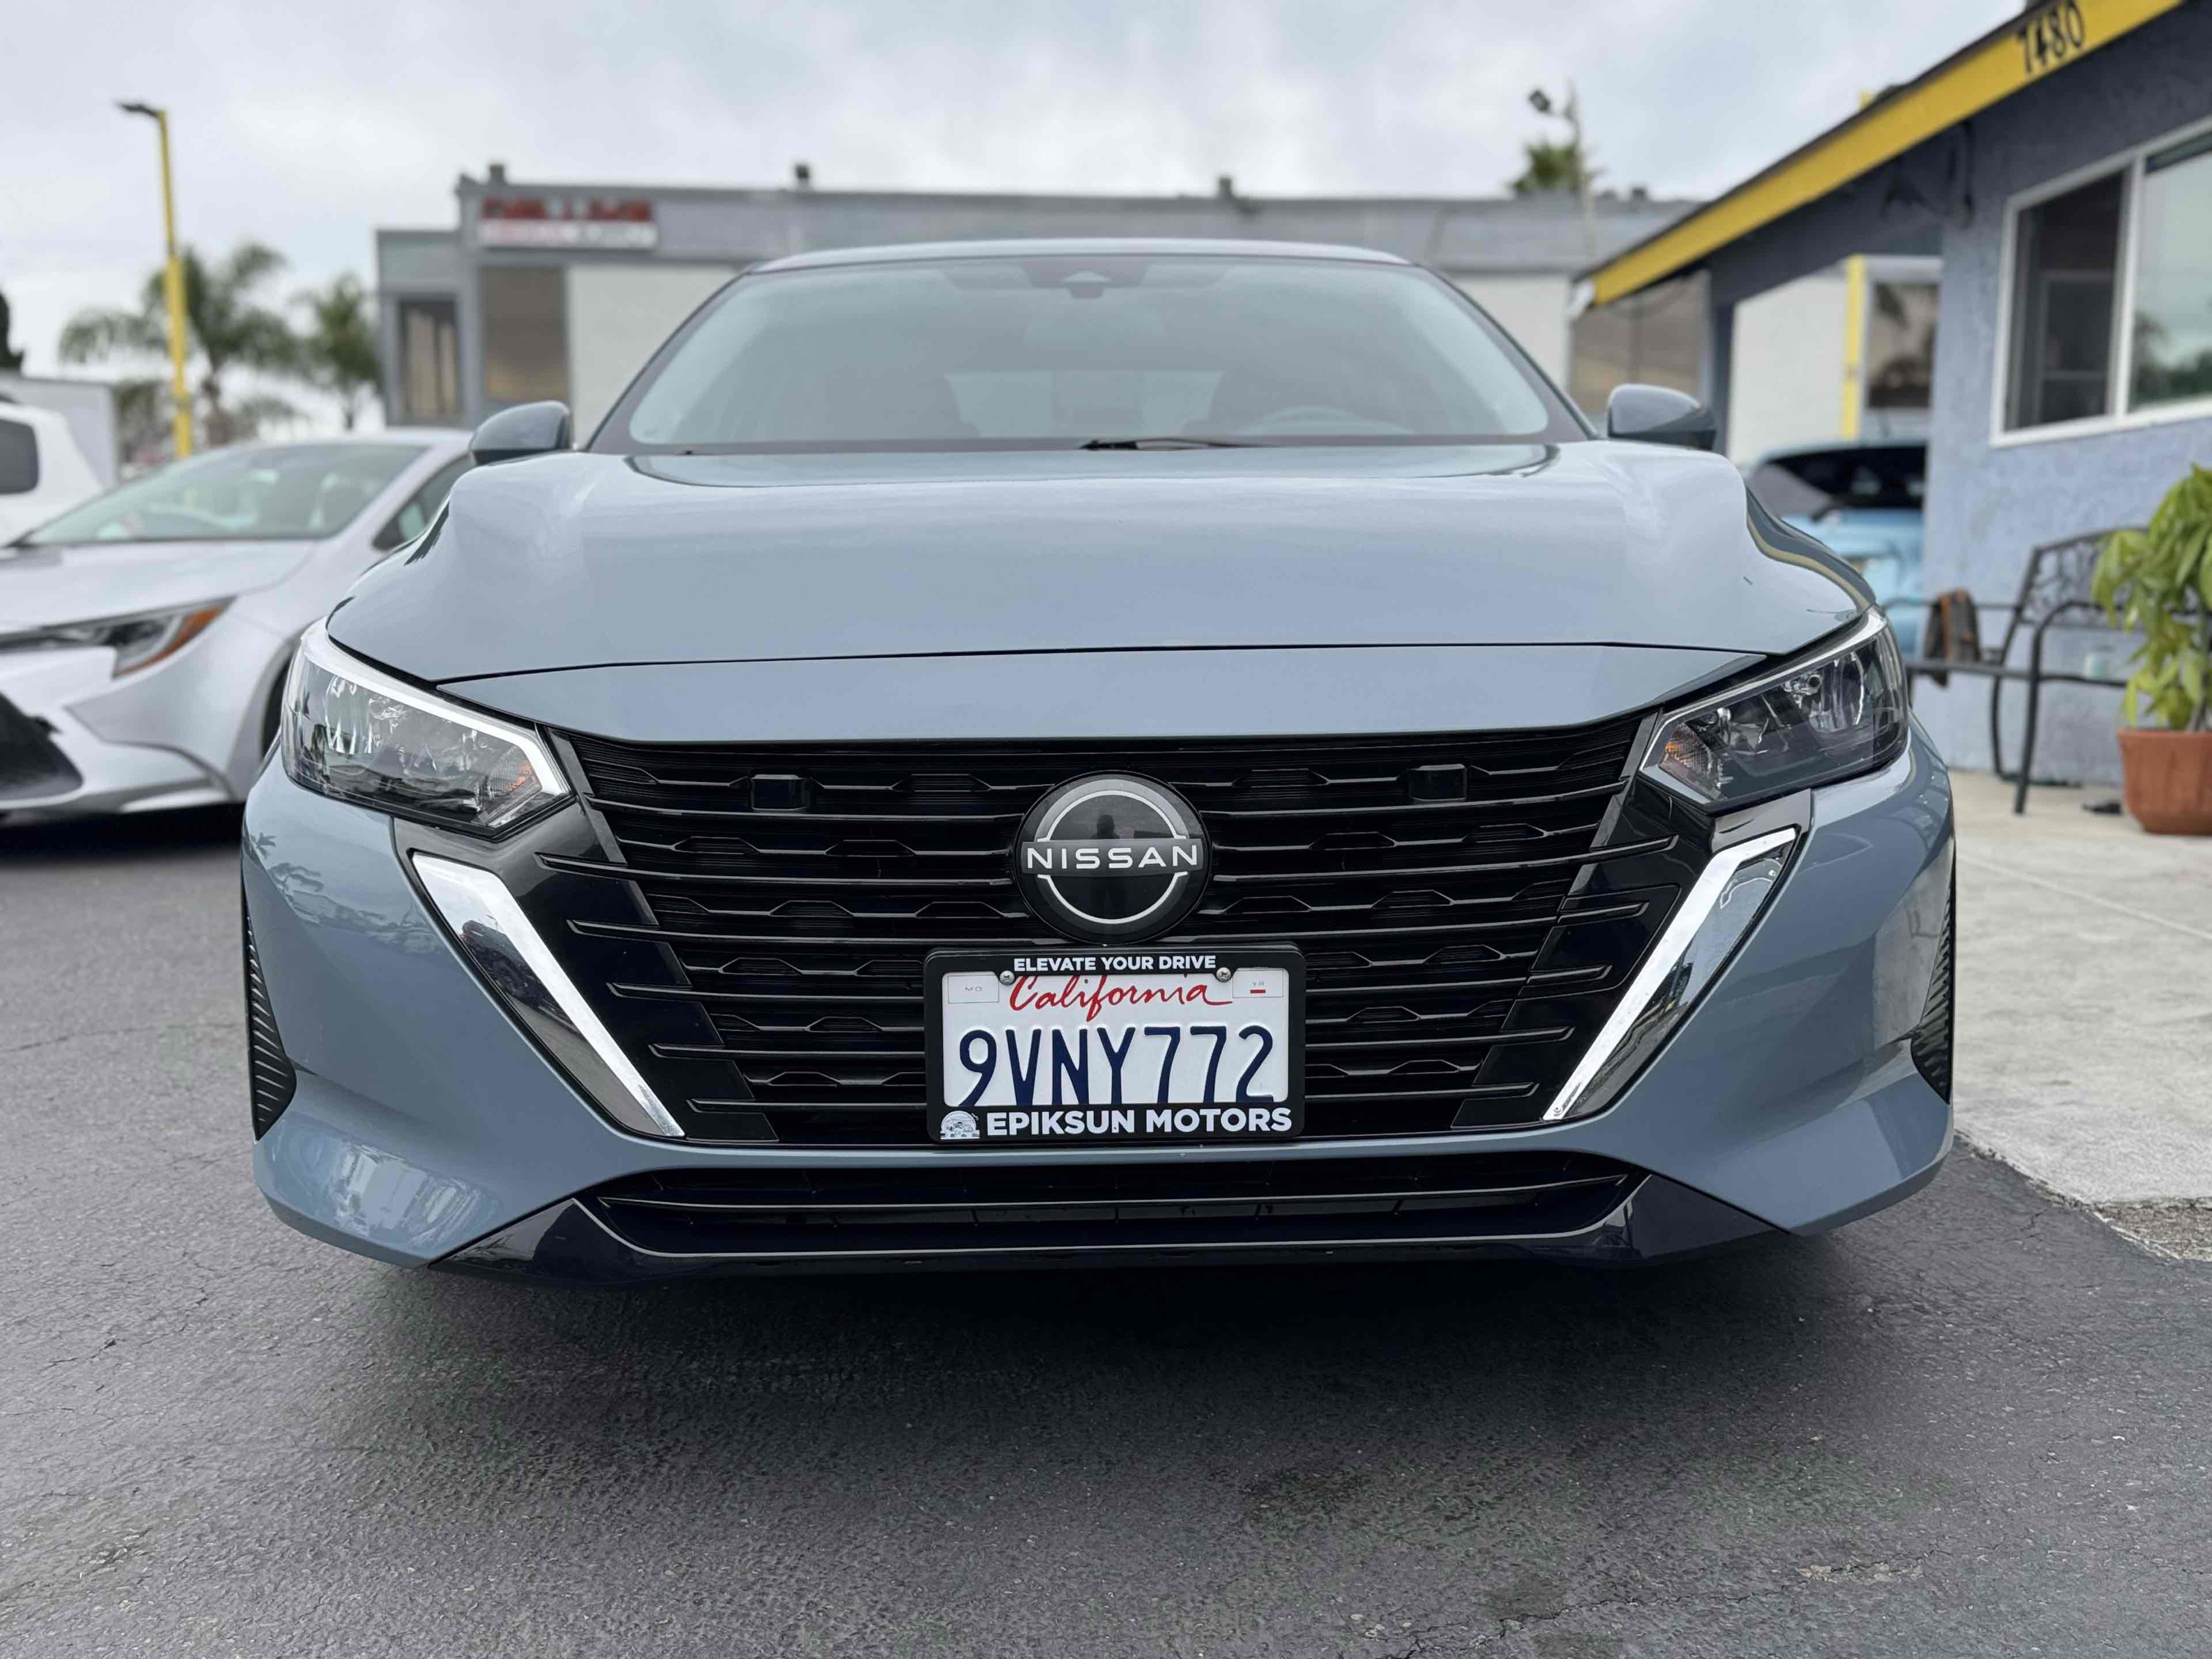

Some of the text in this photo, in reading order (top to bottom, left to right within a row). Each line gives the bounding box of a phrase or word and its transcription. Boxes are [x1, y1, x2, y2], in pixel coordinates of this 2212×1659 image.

[2018, 1, 2084, 73] 7480
[1027, 844, 1198, 869] NISSAN
[1014, 955, 1217, 972] ELEVATE YOUR DRIVE
[1009, 974, 1233, 1022] California
[959, 1025, 1274, 1107] 9VNY772
[987, 1107, 1292, 1136] EPIKSUN MOTORS
